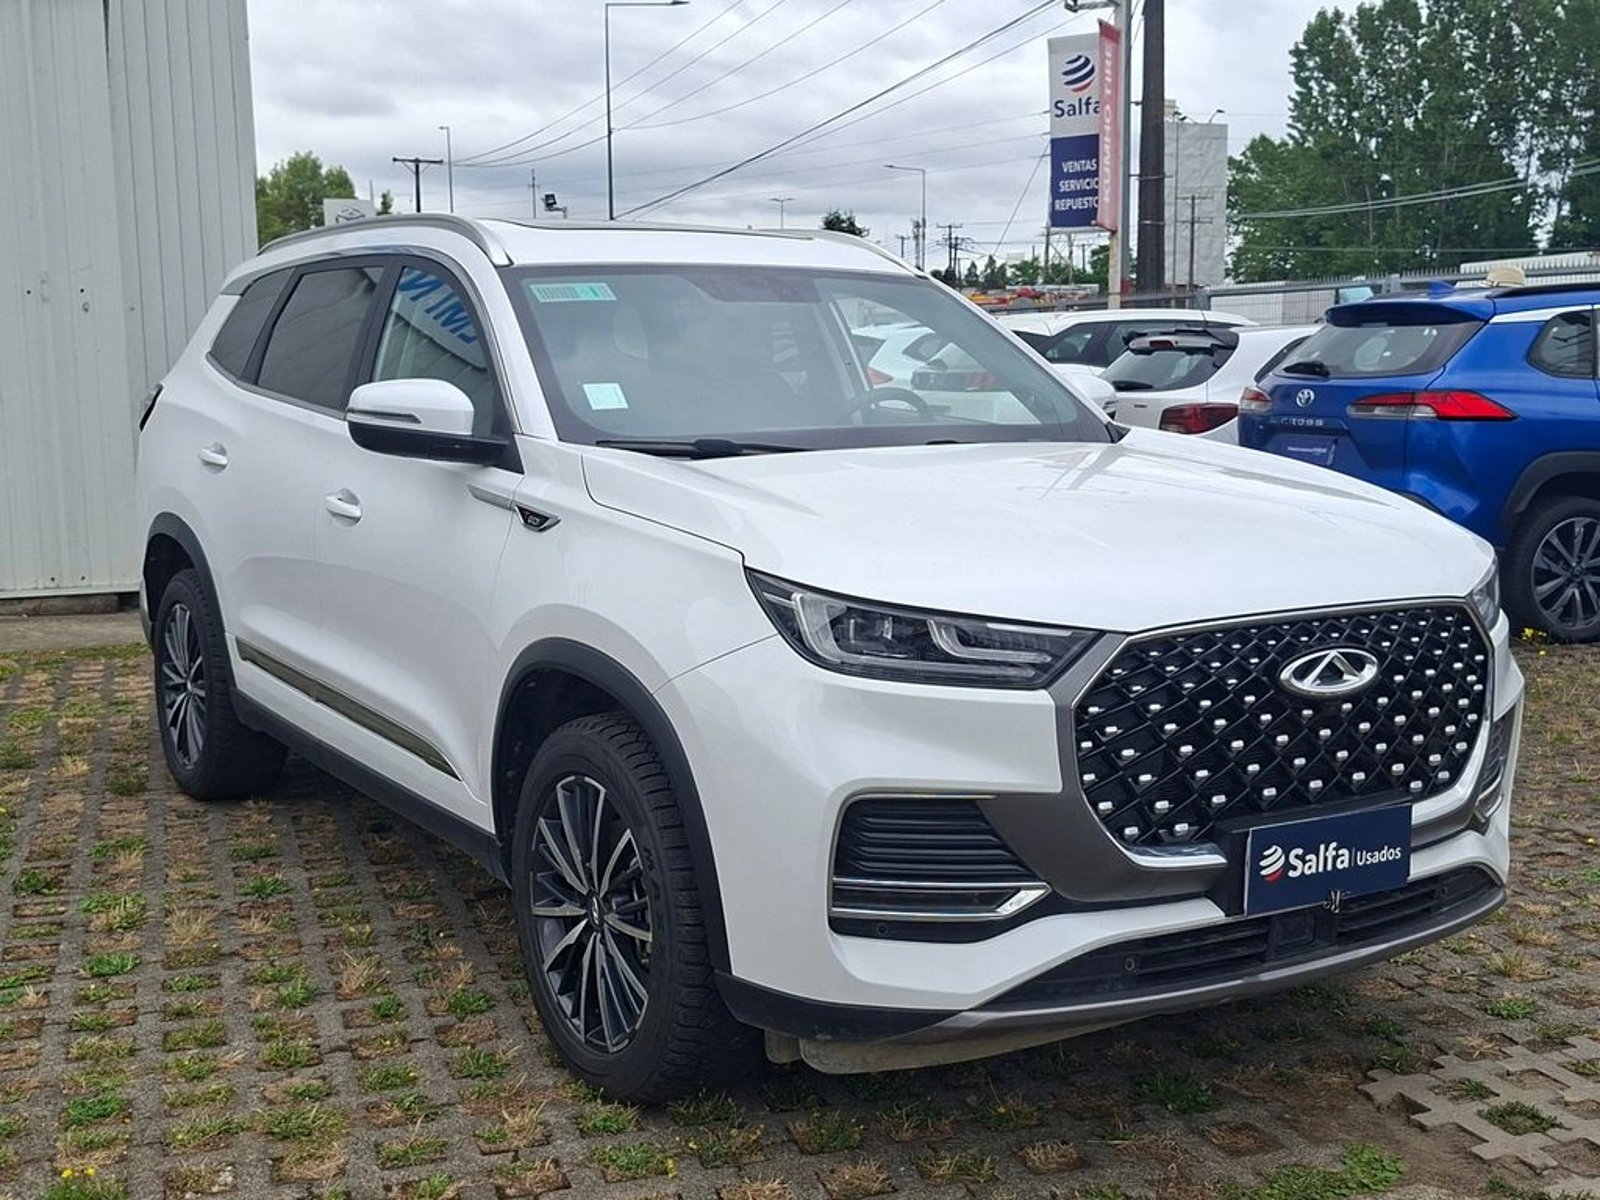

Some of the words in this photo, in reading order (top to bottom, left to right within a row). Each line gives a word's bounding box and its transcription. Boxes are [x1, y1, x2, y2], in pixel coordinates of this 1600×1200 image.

[1054, 96, 1100, 117] Salfa
[1062, 159, 1097, 173] VENTAS
[1287, 842, 1350, 878] Salfa
[1356, 845, 1402, 866] Usados
